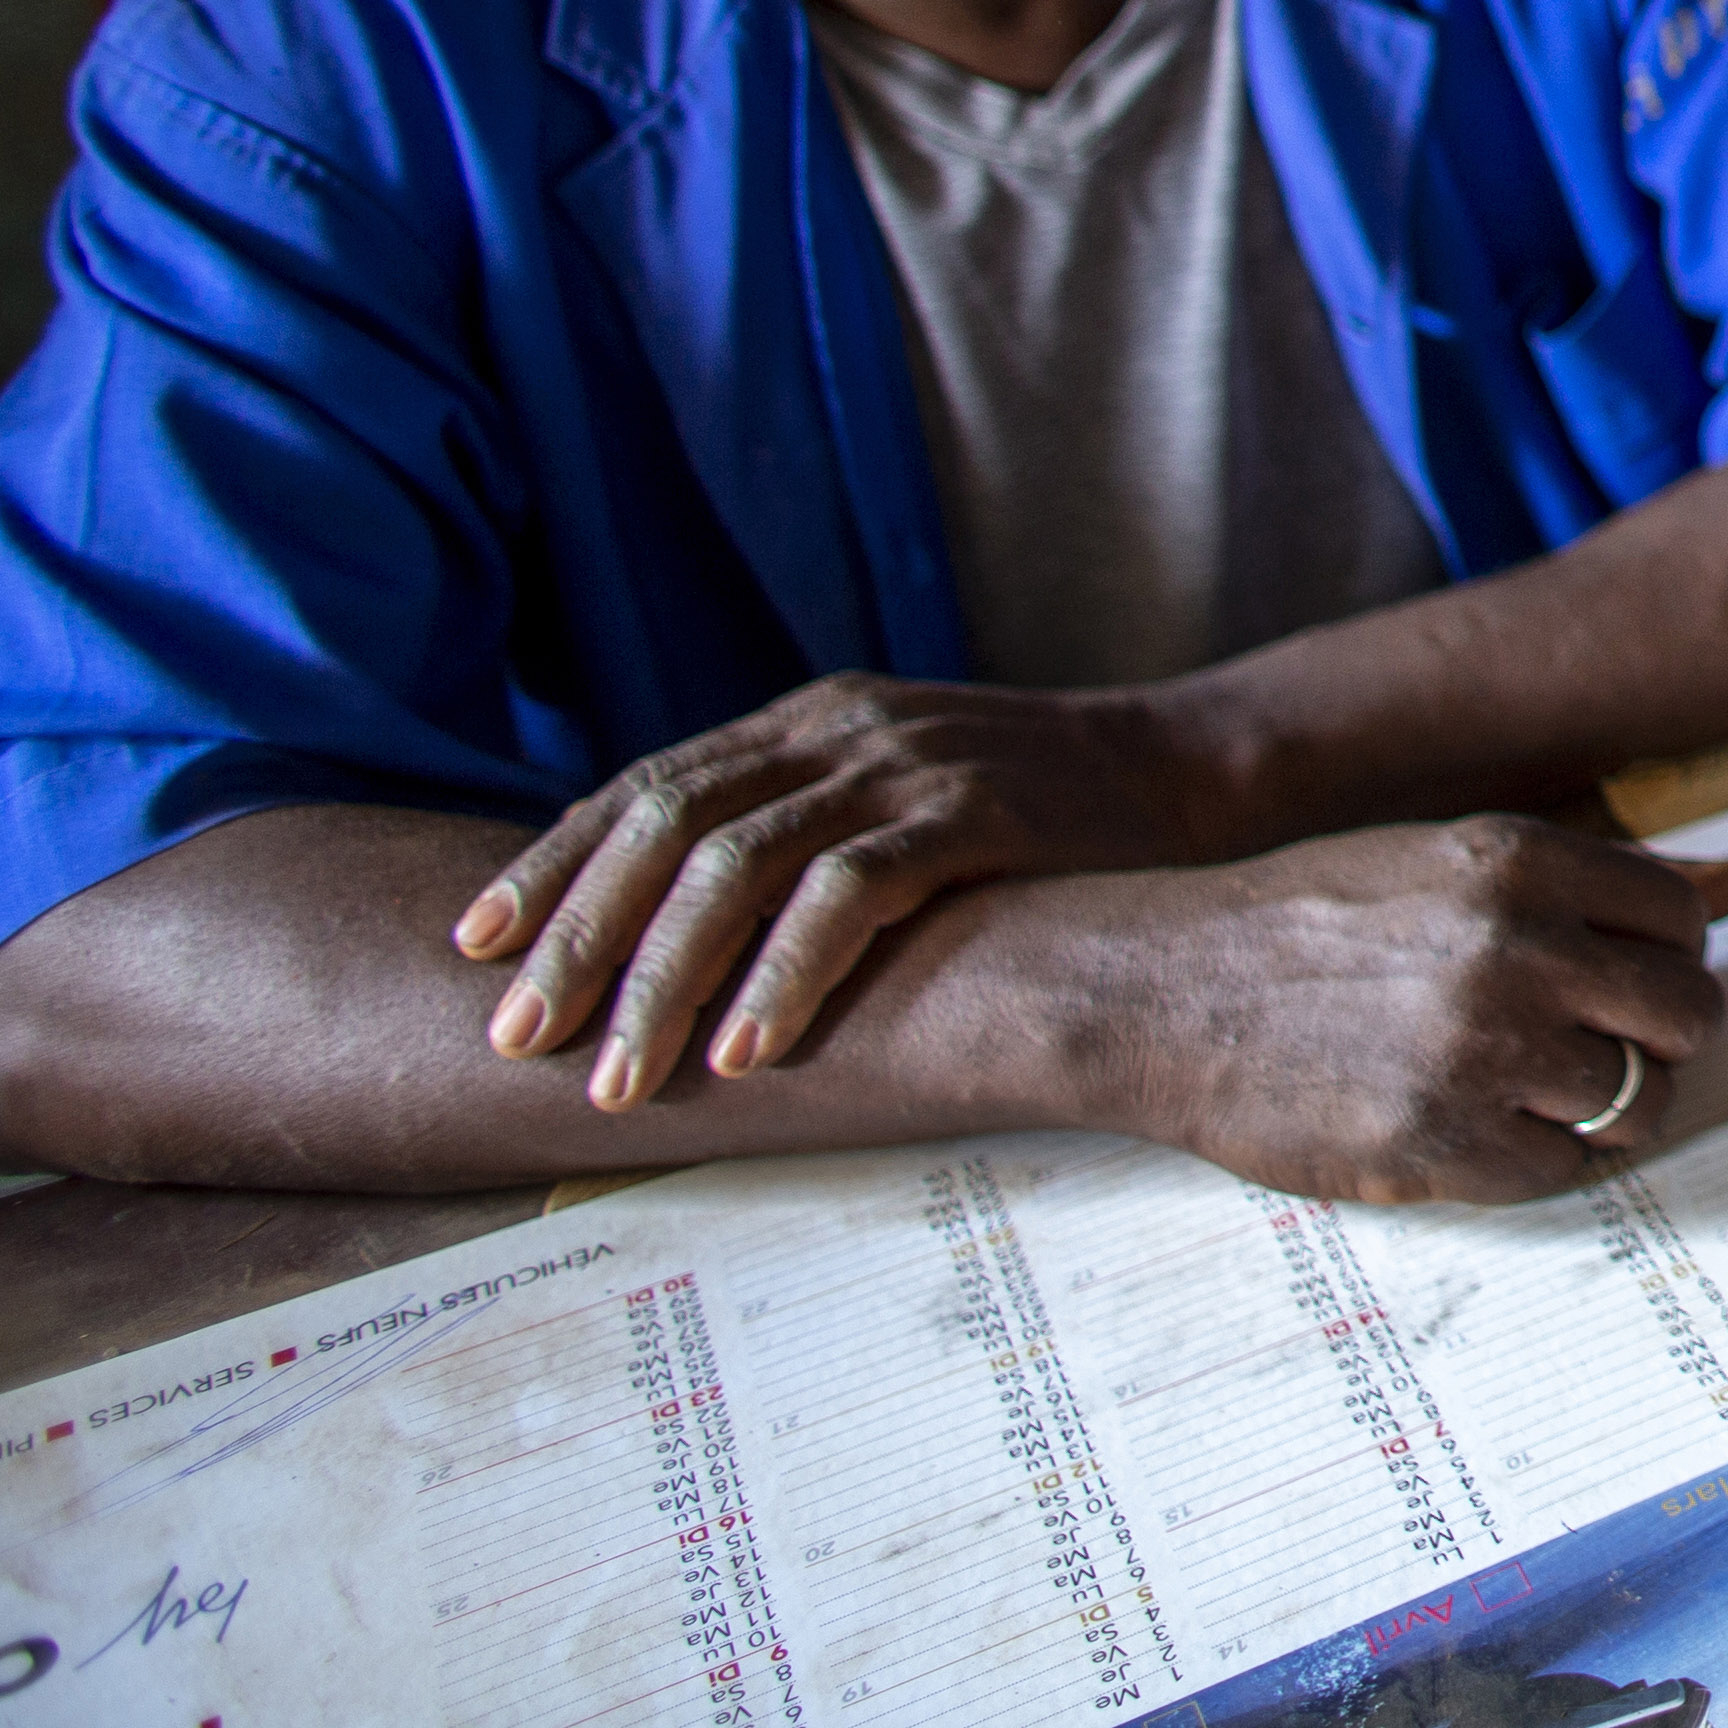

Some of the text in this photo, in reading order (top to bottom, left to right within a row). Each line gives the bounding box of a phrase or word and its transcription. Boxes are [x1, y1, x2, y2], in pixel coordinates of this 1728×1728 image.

[440, 1241, 615, 1311] VÉHICULES
[316, 1299, 429, 1352] NEUFS
[88, 1359, 256, 1430] SERVICES
[1365, 1595, 1455, 1655] Avril
